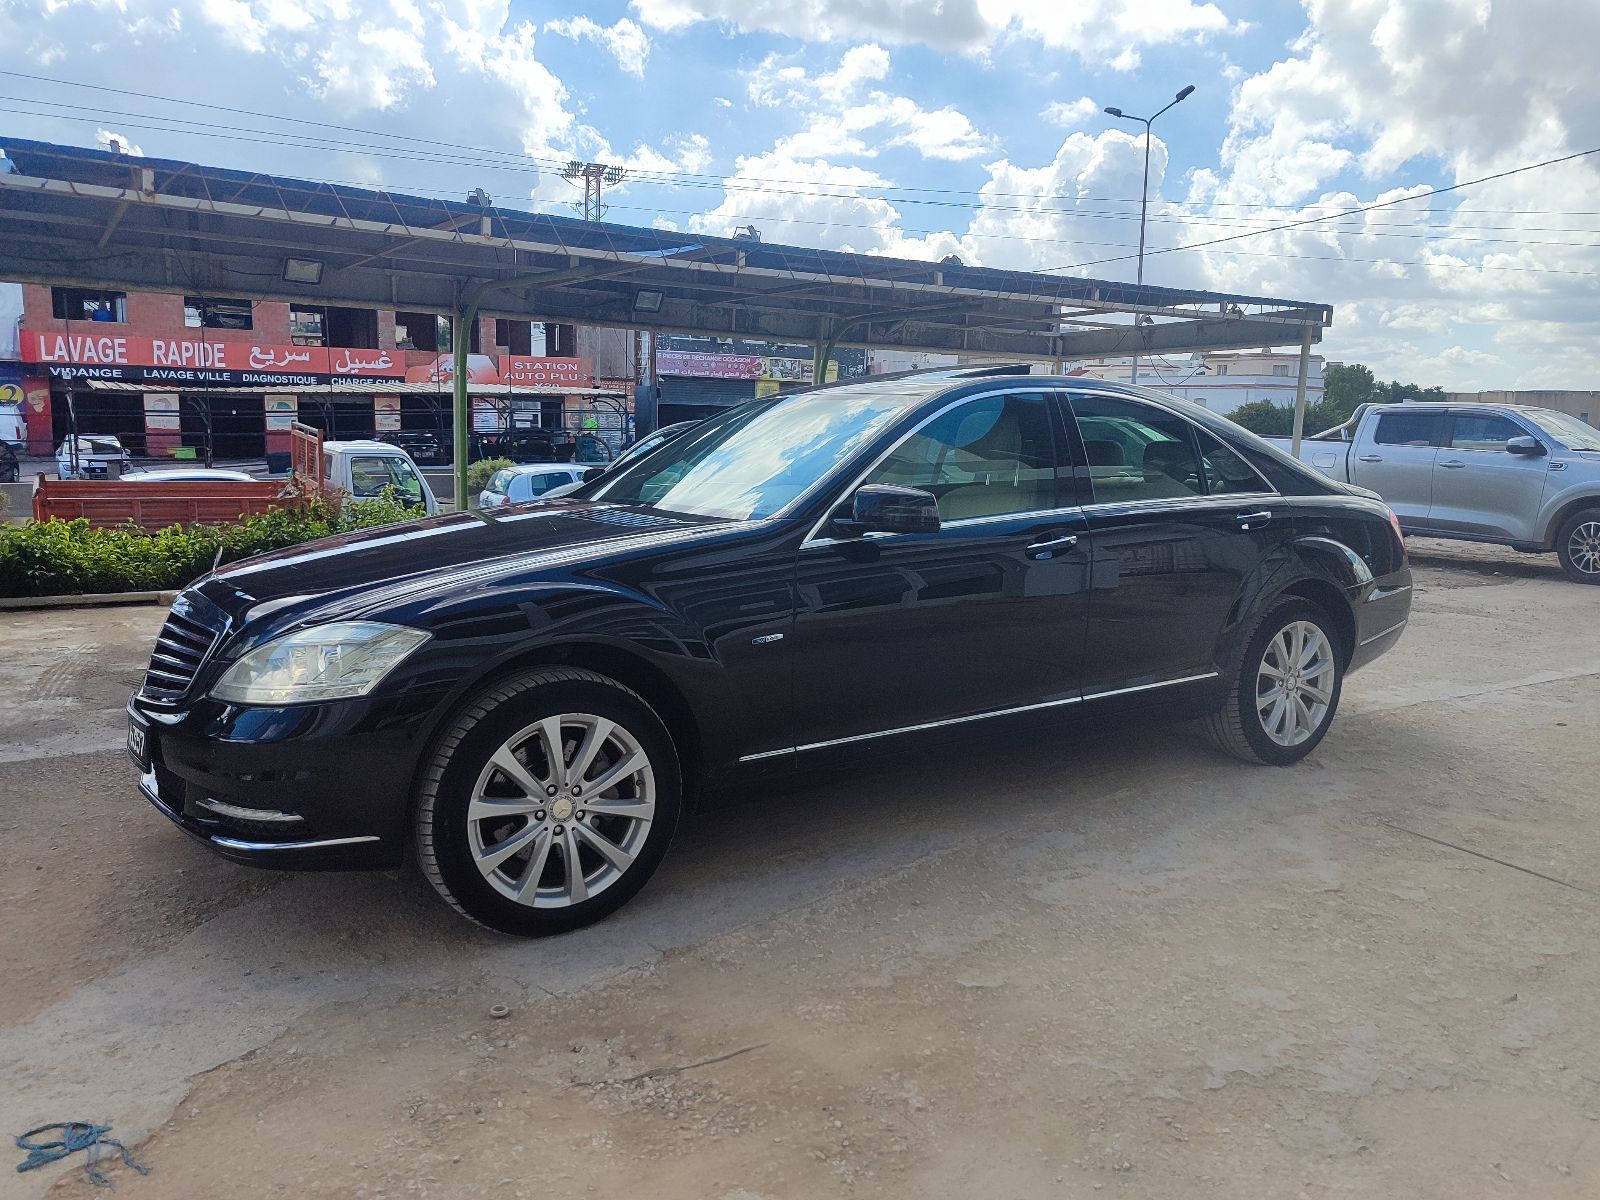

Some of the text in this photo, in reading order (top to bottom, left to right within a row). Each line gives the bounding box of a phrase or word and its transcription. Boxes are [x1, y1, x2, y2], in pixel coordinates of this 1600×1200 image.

[40, 335, 226, 369] LAVAGE RAPIDE
[249, 346, 393, 374] غسيل سريع
[514, 361, 578, 370] STATION
[49, 367, 123, 378] VIDANGE
[143, 369, 195, 380] LAVAGE
[197, 371, 231, 381] VILLE
[242, 374, 318, 385] DIAGNOSTIQUE
[504, 372, 546, 380] AUTO
